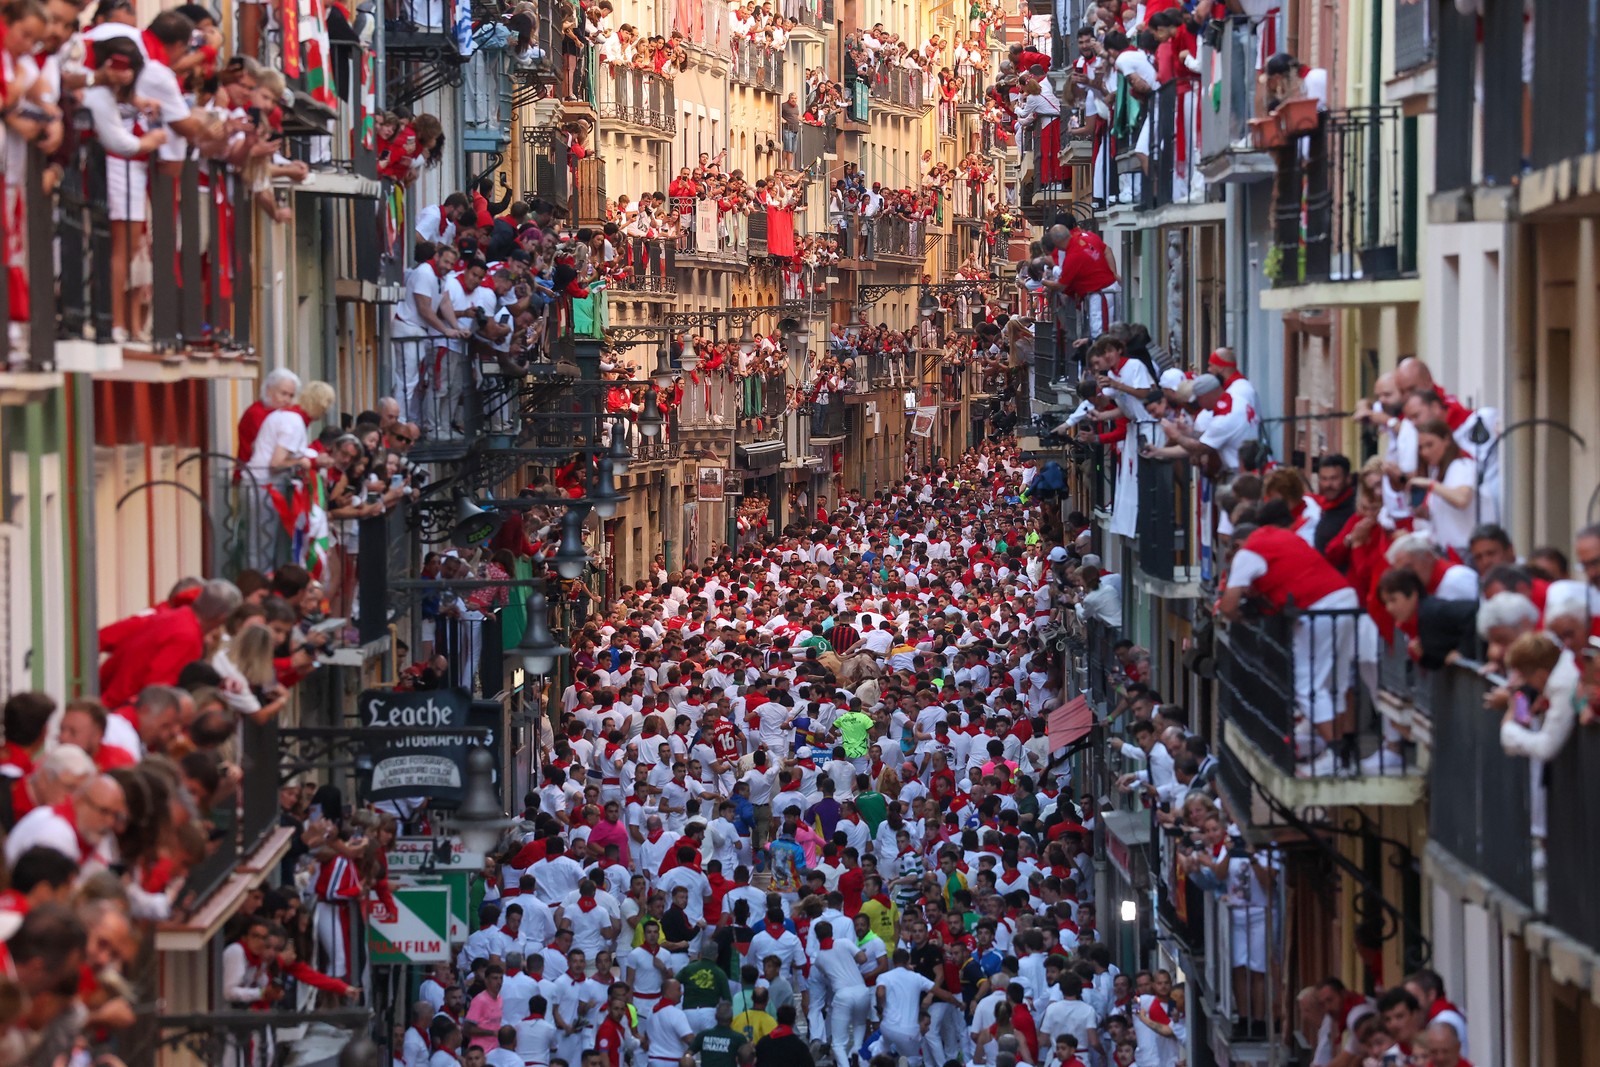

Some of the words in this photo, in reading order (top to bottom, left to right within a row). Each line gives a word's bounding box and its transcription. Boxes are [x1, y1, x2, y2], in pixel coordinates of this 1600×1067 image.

[818, 640, 827, 655] 9
[368, 698, 452, 728] Leache
[717, 731, 735, 751] 16
[388, 855, 404, 865] EN
[408, 855, 422, 865] EL
